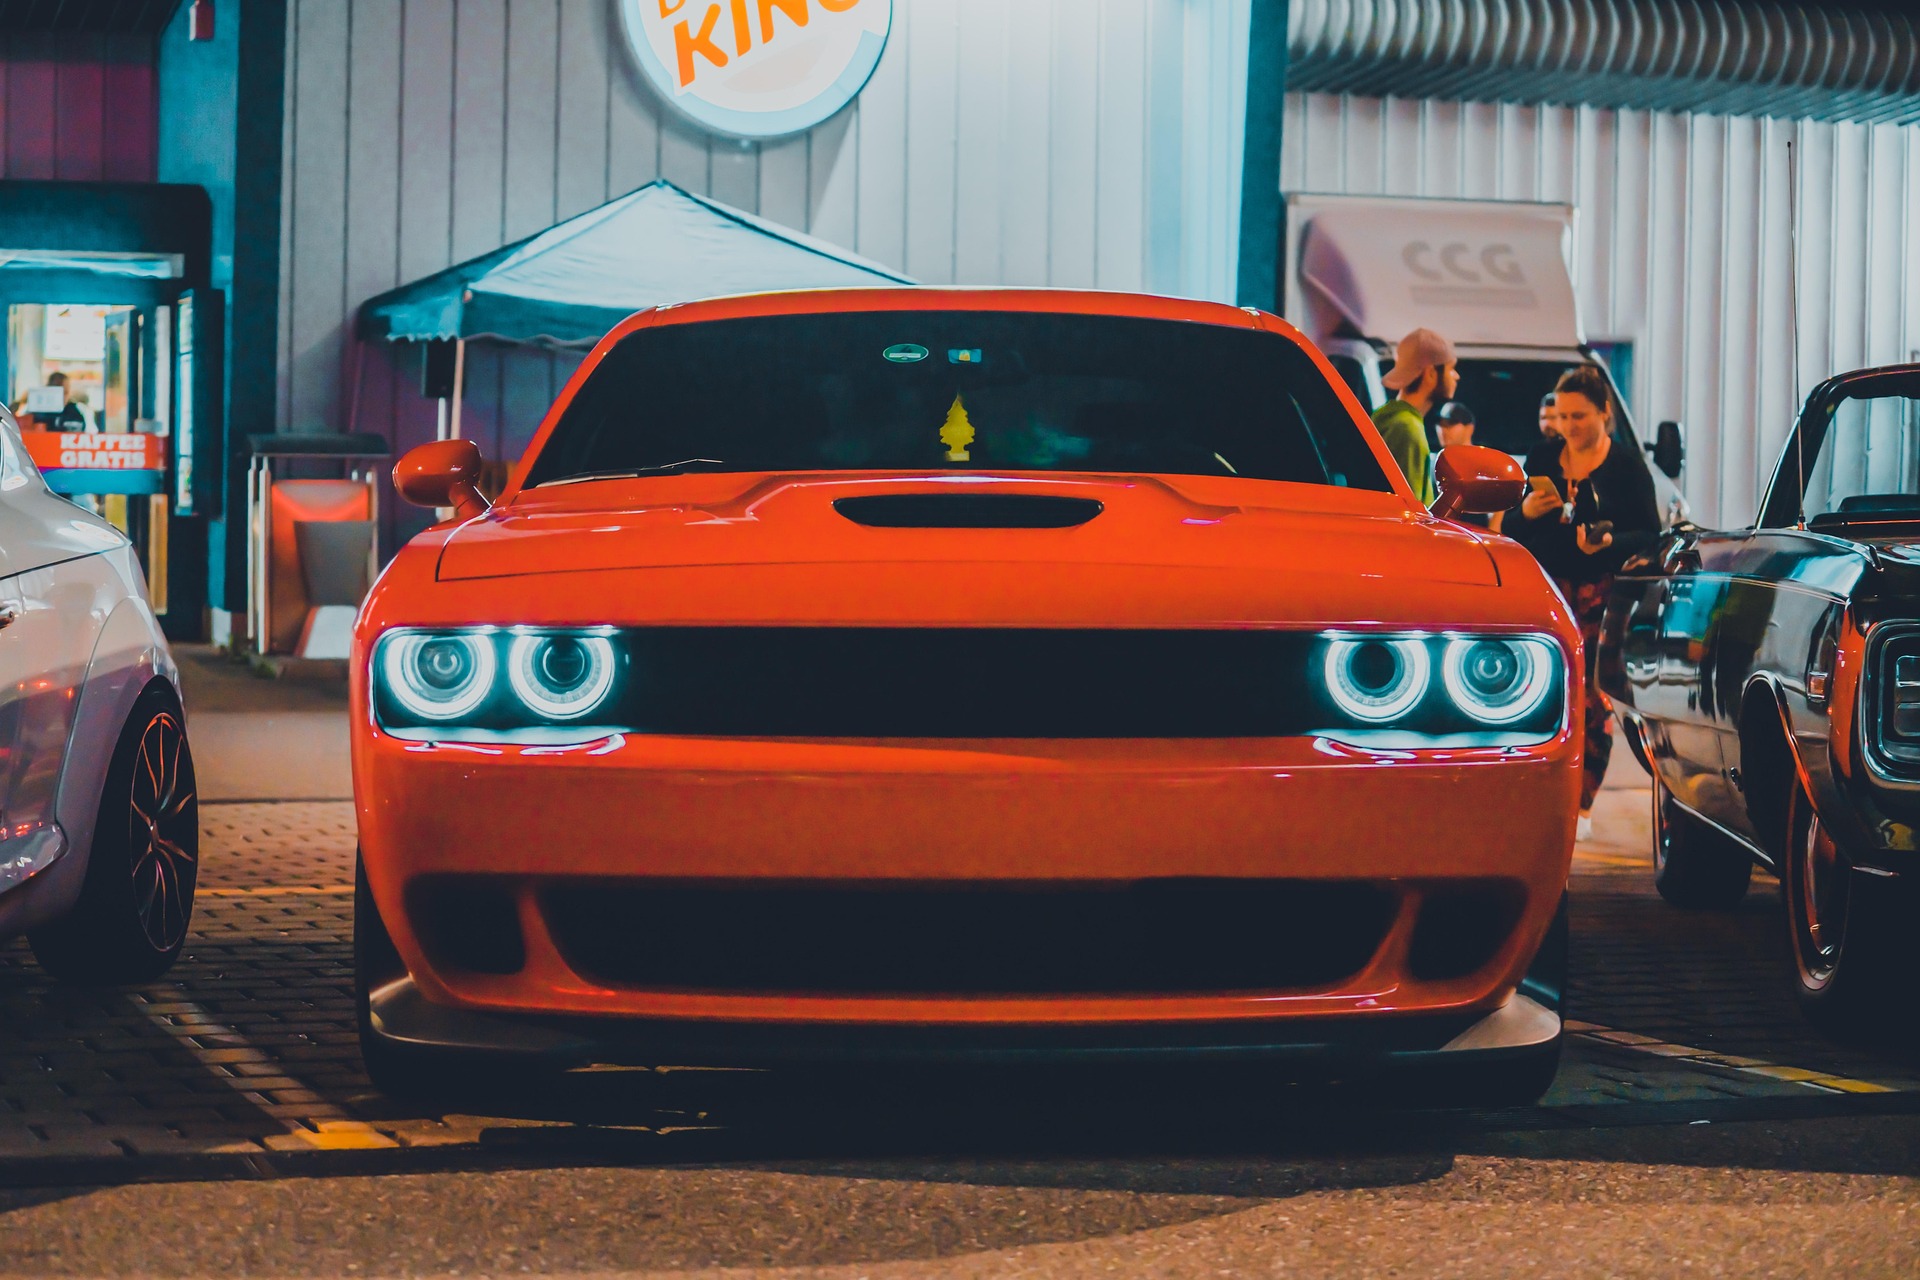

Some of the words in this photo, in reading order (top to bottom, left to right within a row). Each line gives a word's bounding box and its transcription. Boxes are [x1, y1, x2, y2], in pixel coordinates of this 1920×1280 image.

[673, 0, 861, 87] KIN
[1402, 241, 1527, 284] CCG
[60, 433, 146, 450] KAFFEE
[60, 450, 146, 468] GRATIS
